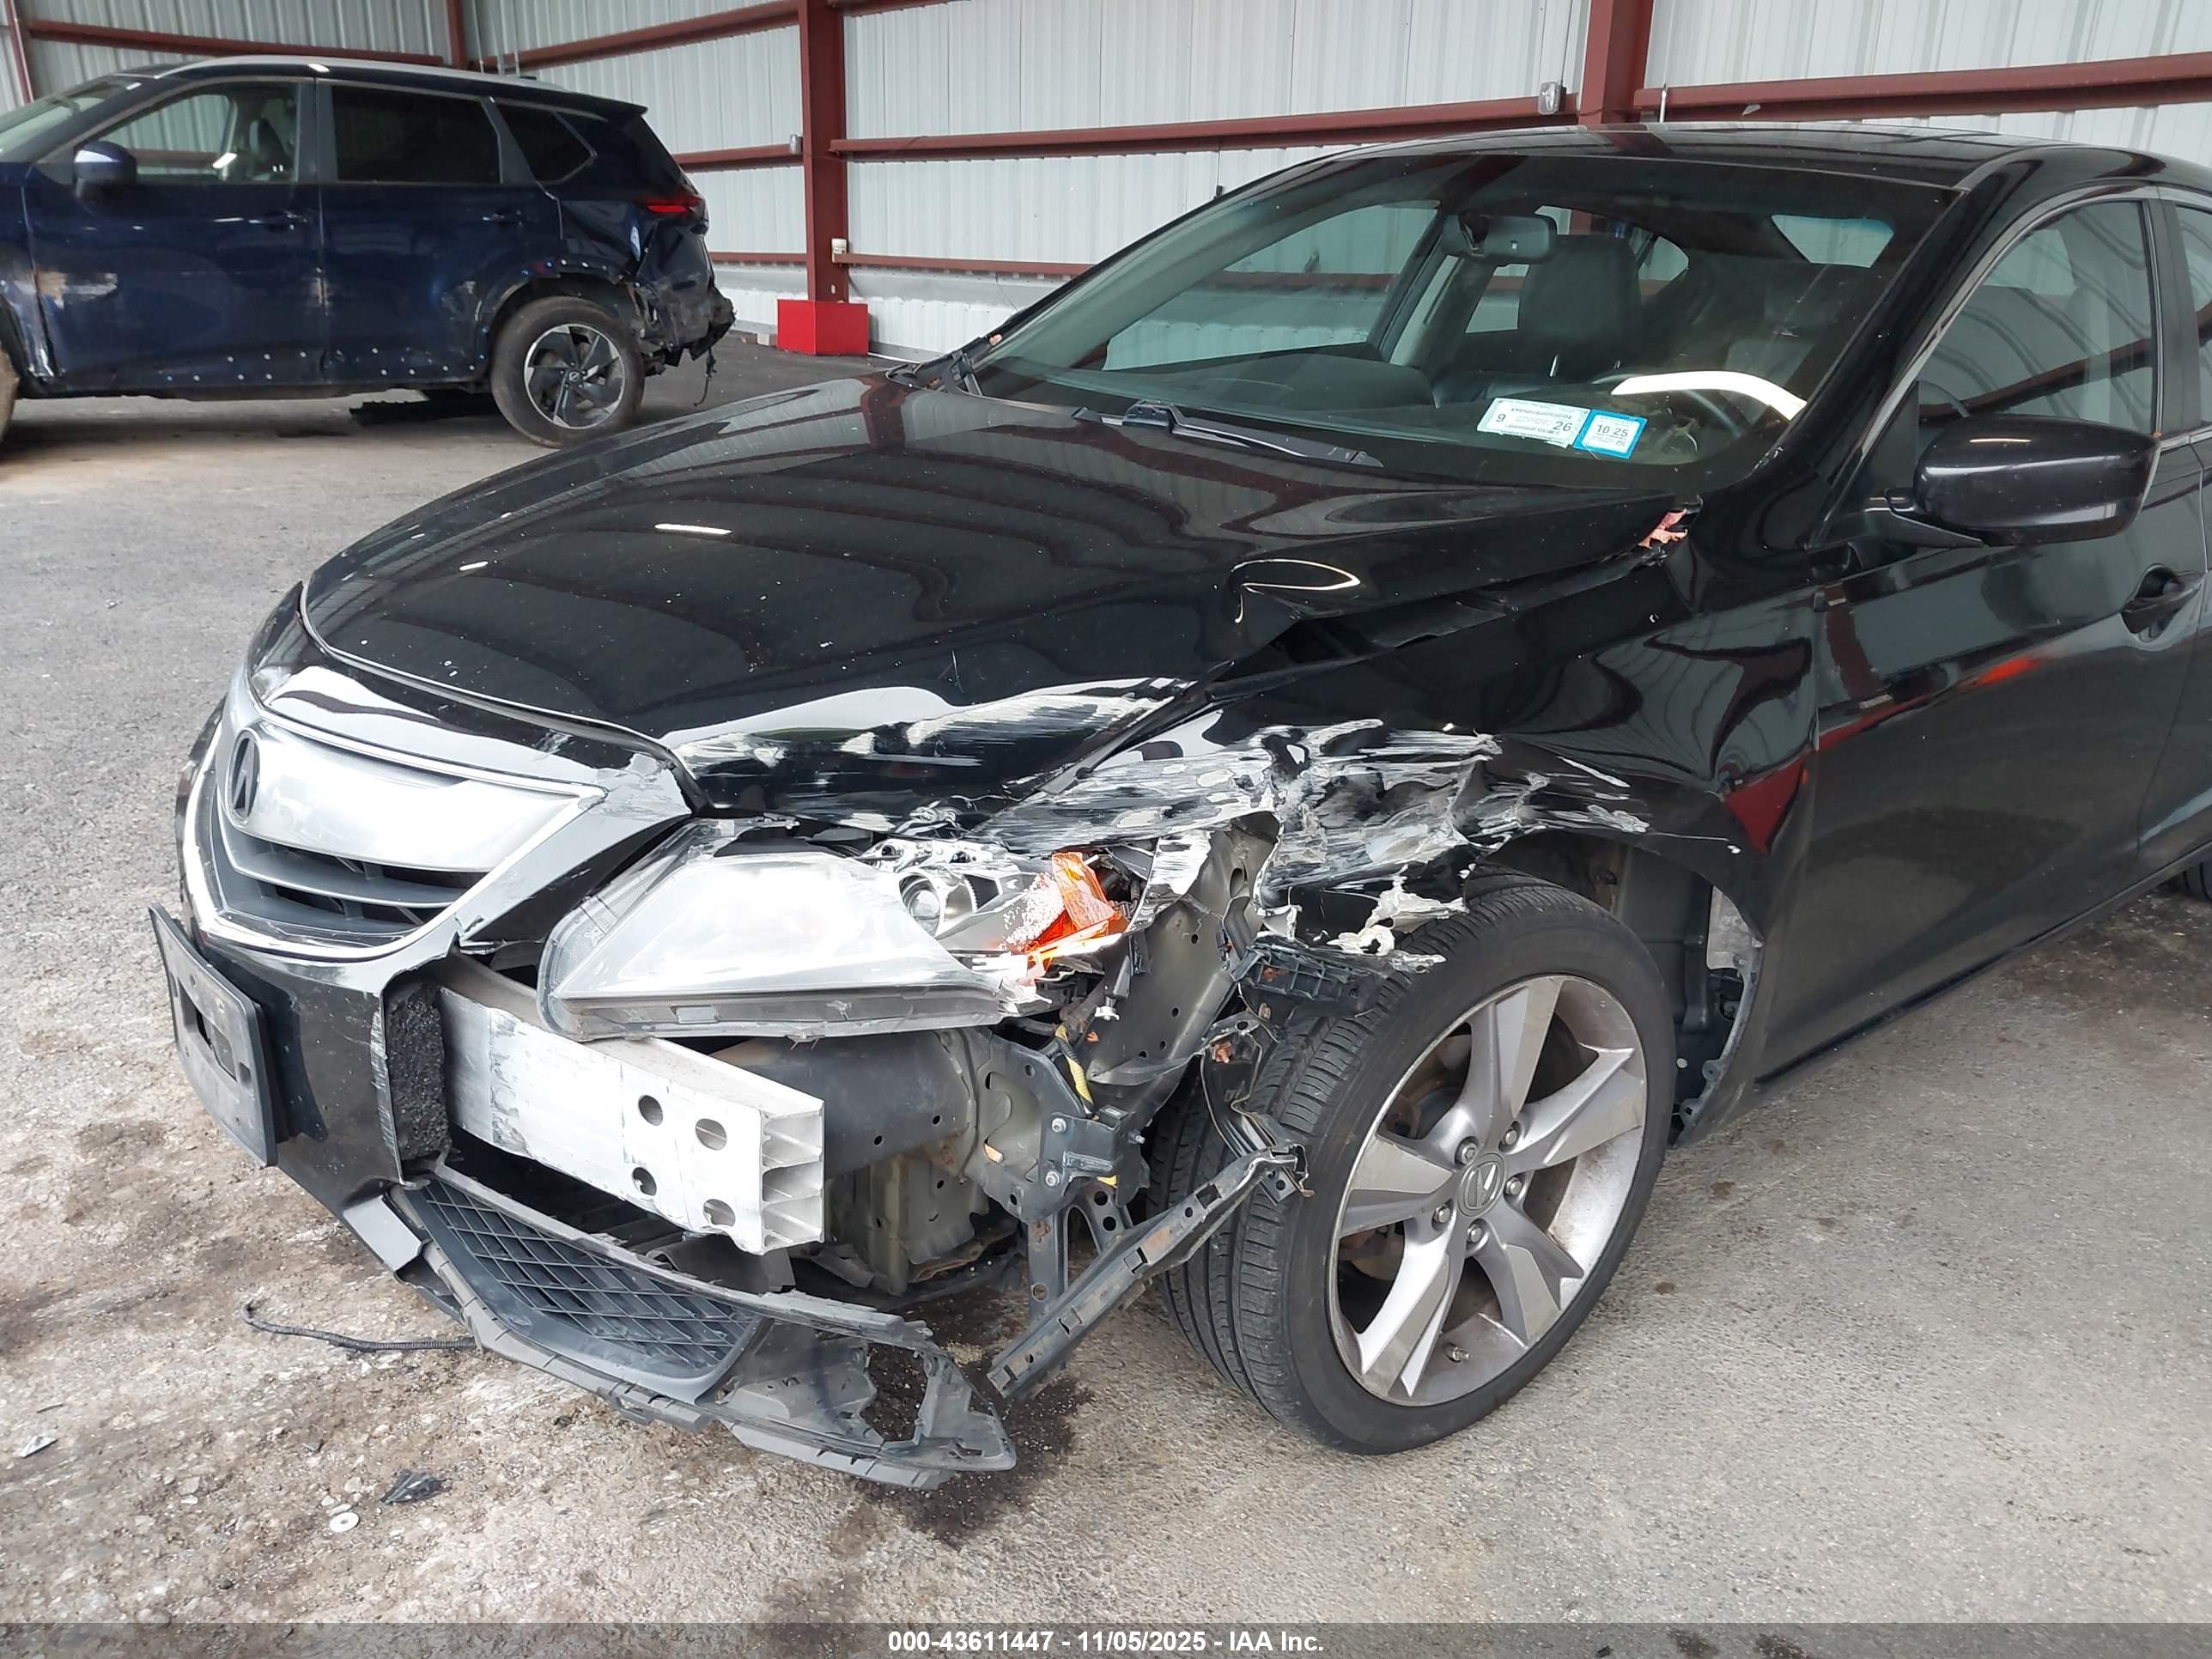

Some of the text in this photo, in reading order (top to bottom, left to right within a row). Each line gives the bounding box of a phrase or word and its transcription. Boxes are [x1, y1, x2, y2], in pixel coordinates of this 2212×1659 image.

[1496, 413, 1506, 422] 9
[1553, 421, 1573, 432] 26
[1597, 424, 1611, 434] 10
[1613, 428, 1629, 437] 25
